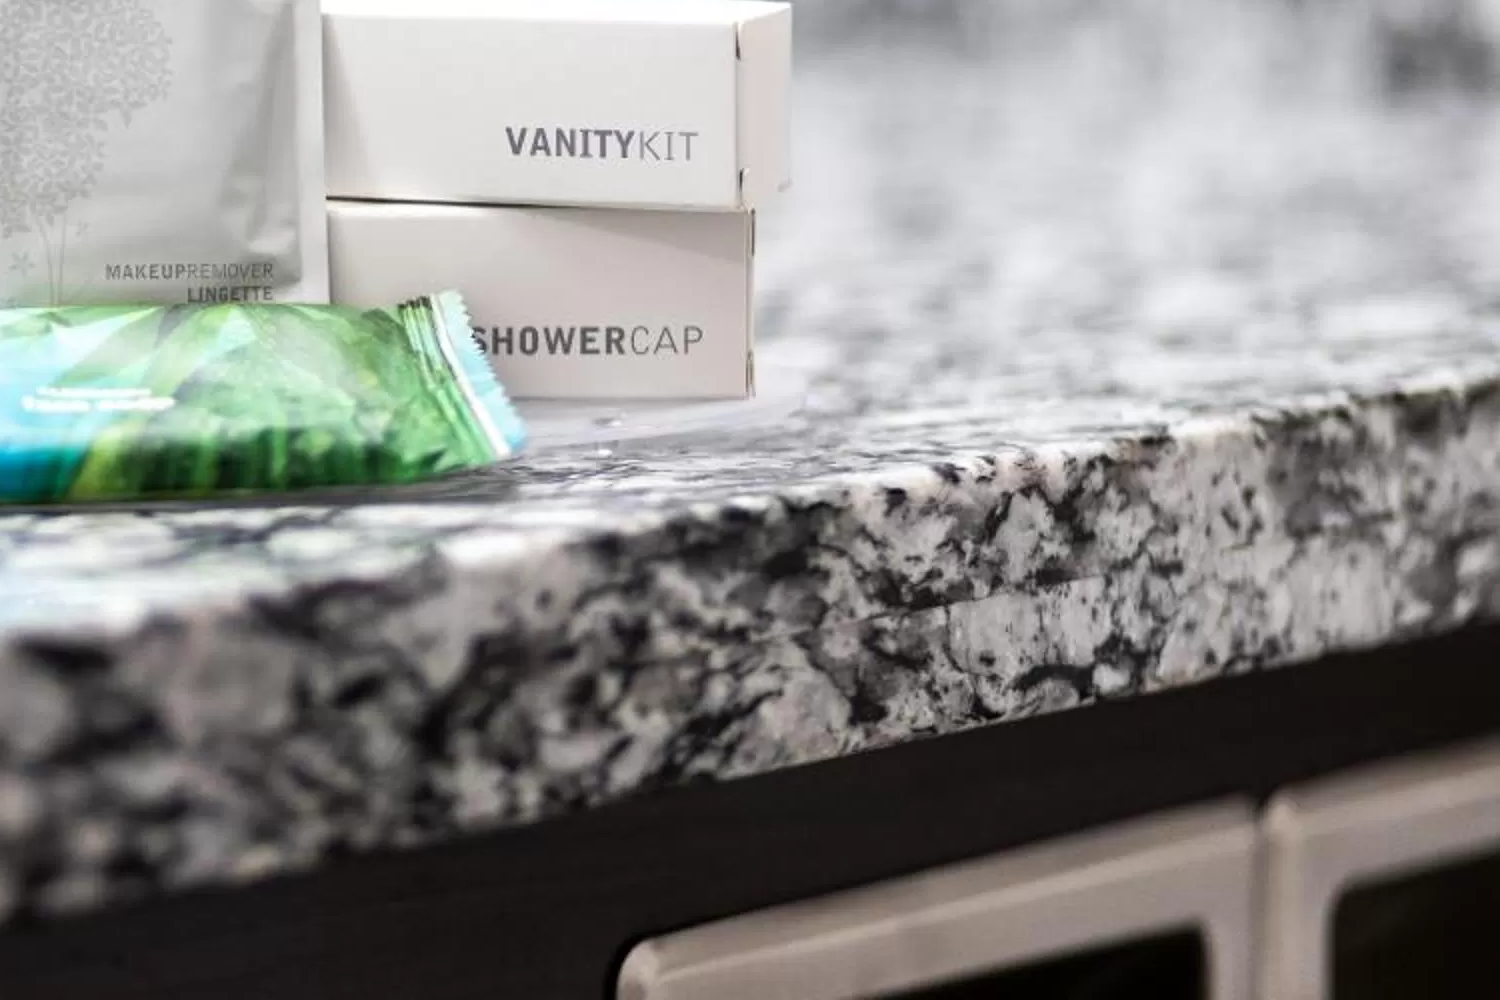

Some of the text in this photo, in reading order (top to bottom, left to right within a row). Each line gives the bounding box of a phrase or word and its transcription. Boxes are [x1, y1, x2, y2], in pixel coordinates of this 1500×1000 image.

[505, 126, 699, 162] VANITYKIT
[105, 263, 274, 281] MAKEUPREMOVER
[186, 286, 274, 303] LINGETTE
